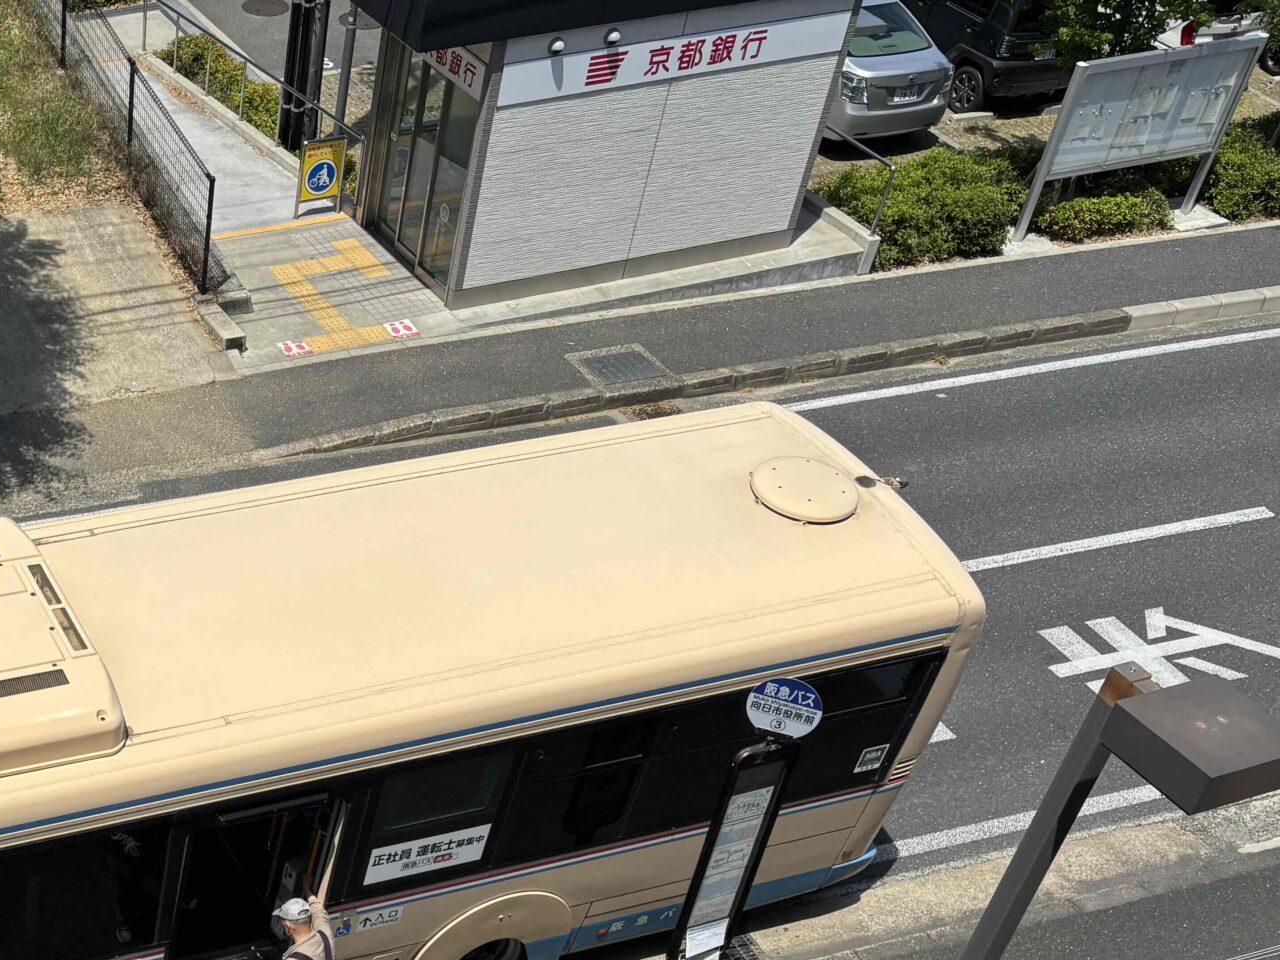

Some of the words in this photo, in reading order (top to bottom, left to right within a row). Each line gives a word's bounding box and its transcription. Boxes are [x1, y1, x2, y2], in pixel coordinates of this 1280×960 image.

[644, 29, 768, 76] 京都銀行
[426, 48, 477, 88] 都銀行
[763, 682, 816, 707] 阪急バス
[750, 700, 816, 725] 向日市役所前
[371, 848, 412, 867] 正社員
[370, 917, 399, 927] ENTRANCE
[375, 909, 399, 921] 入口
[609, 908, 677, 932] 阪急バ
